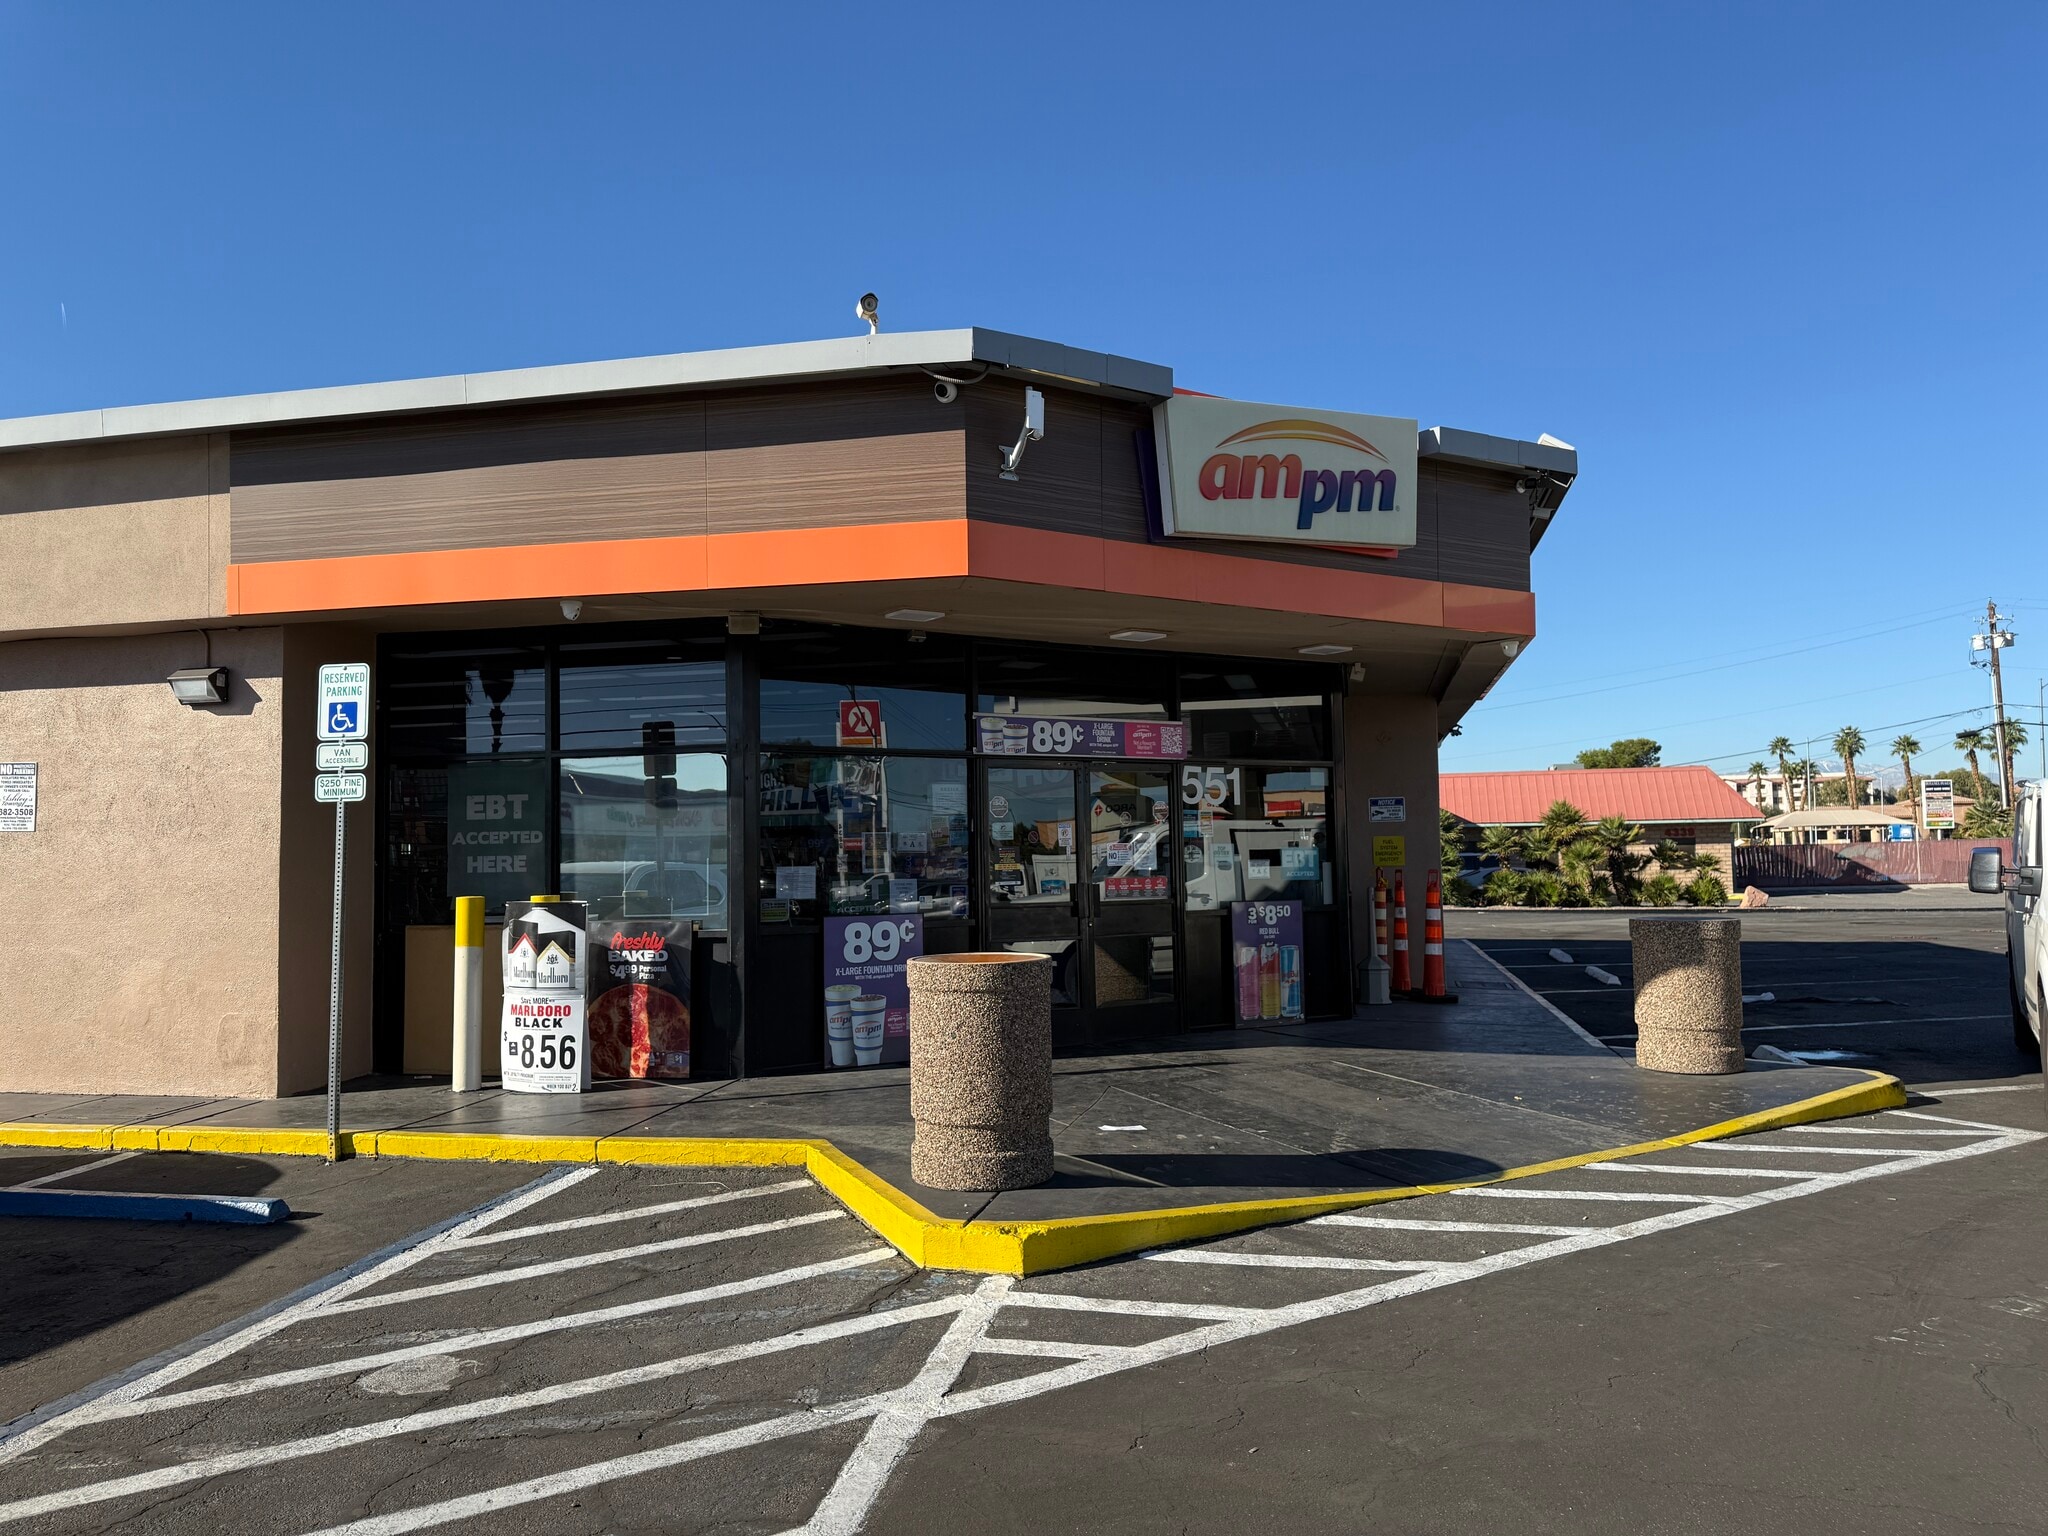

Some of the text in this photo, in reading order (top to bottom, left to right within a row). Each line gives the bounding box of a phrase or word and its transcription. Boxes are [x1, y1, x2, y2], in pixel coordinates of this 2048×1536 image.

[1199, 453, 1397, 530] ampm
[324, 672, 365, 684] RESERVED
[326, 685, 363, 697] PARKING
[1093, 722, 1114, 730] X-LARGE
[1032, 720, 1085, 753] 89¢
[1092, 729, 1116, 737] FOUNTAIN
[334, 748, 351, 757] VAN
[0, 764, 13, 775] NO
[320, 778, 361, 788] $250 FINE
[1182, 765, 1241, 805] 551
[323, 787, 358, 797] MINIMUM
[466, 793, 529, 820] EBT
[452, 830, 544, 845] ACCEPTED
[466, 854, 528, 873] HERE
[1286, 850, 1318, 868] EBT
[1248, 907, 1257, 920] 3
[1259, 927, 1280, 935] RED BULL
[609, 931, 666, 953] Freshly
[843, 919, 915, 964] 89¢
[607, 950, 669, 962] BAKED
[638, 964, 667, 973] Personal
[835, 963, 907, 977] X-LARGE FOUNTAIN DRIN
[538, 967, 569, 984] Marlboro
[638, 972, 655, 980] Pizza
[532, 997, 549, 1005] MORE
[510, 1003, 572, 1017] MARLBORO
[515, 1017, 564, 1028] BLACK
[854, 1023, 882, 1036] ampm
[521, 1034, 576, 1070] 8.56
